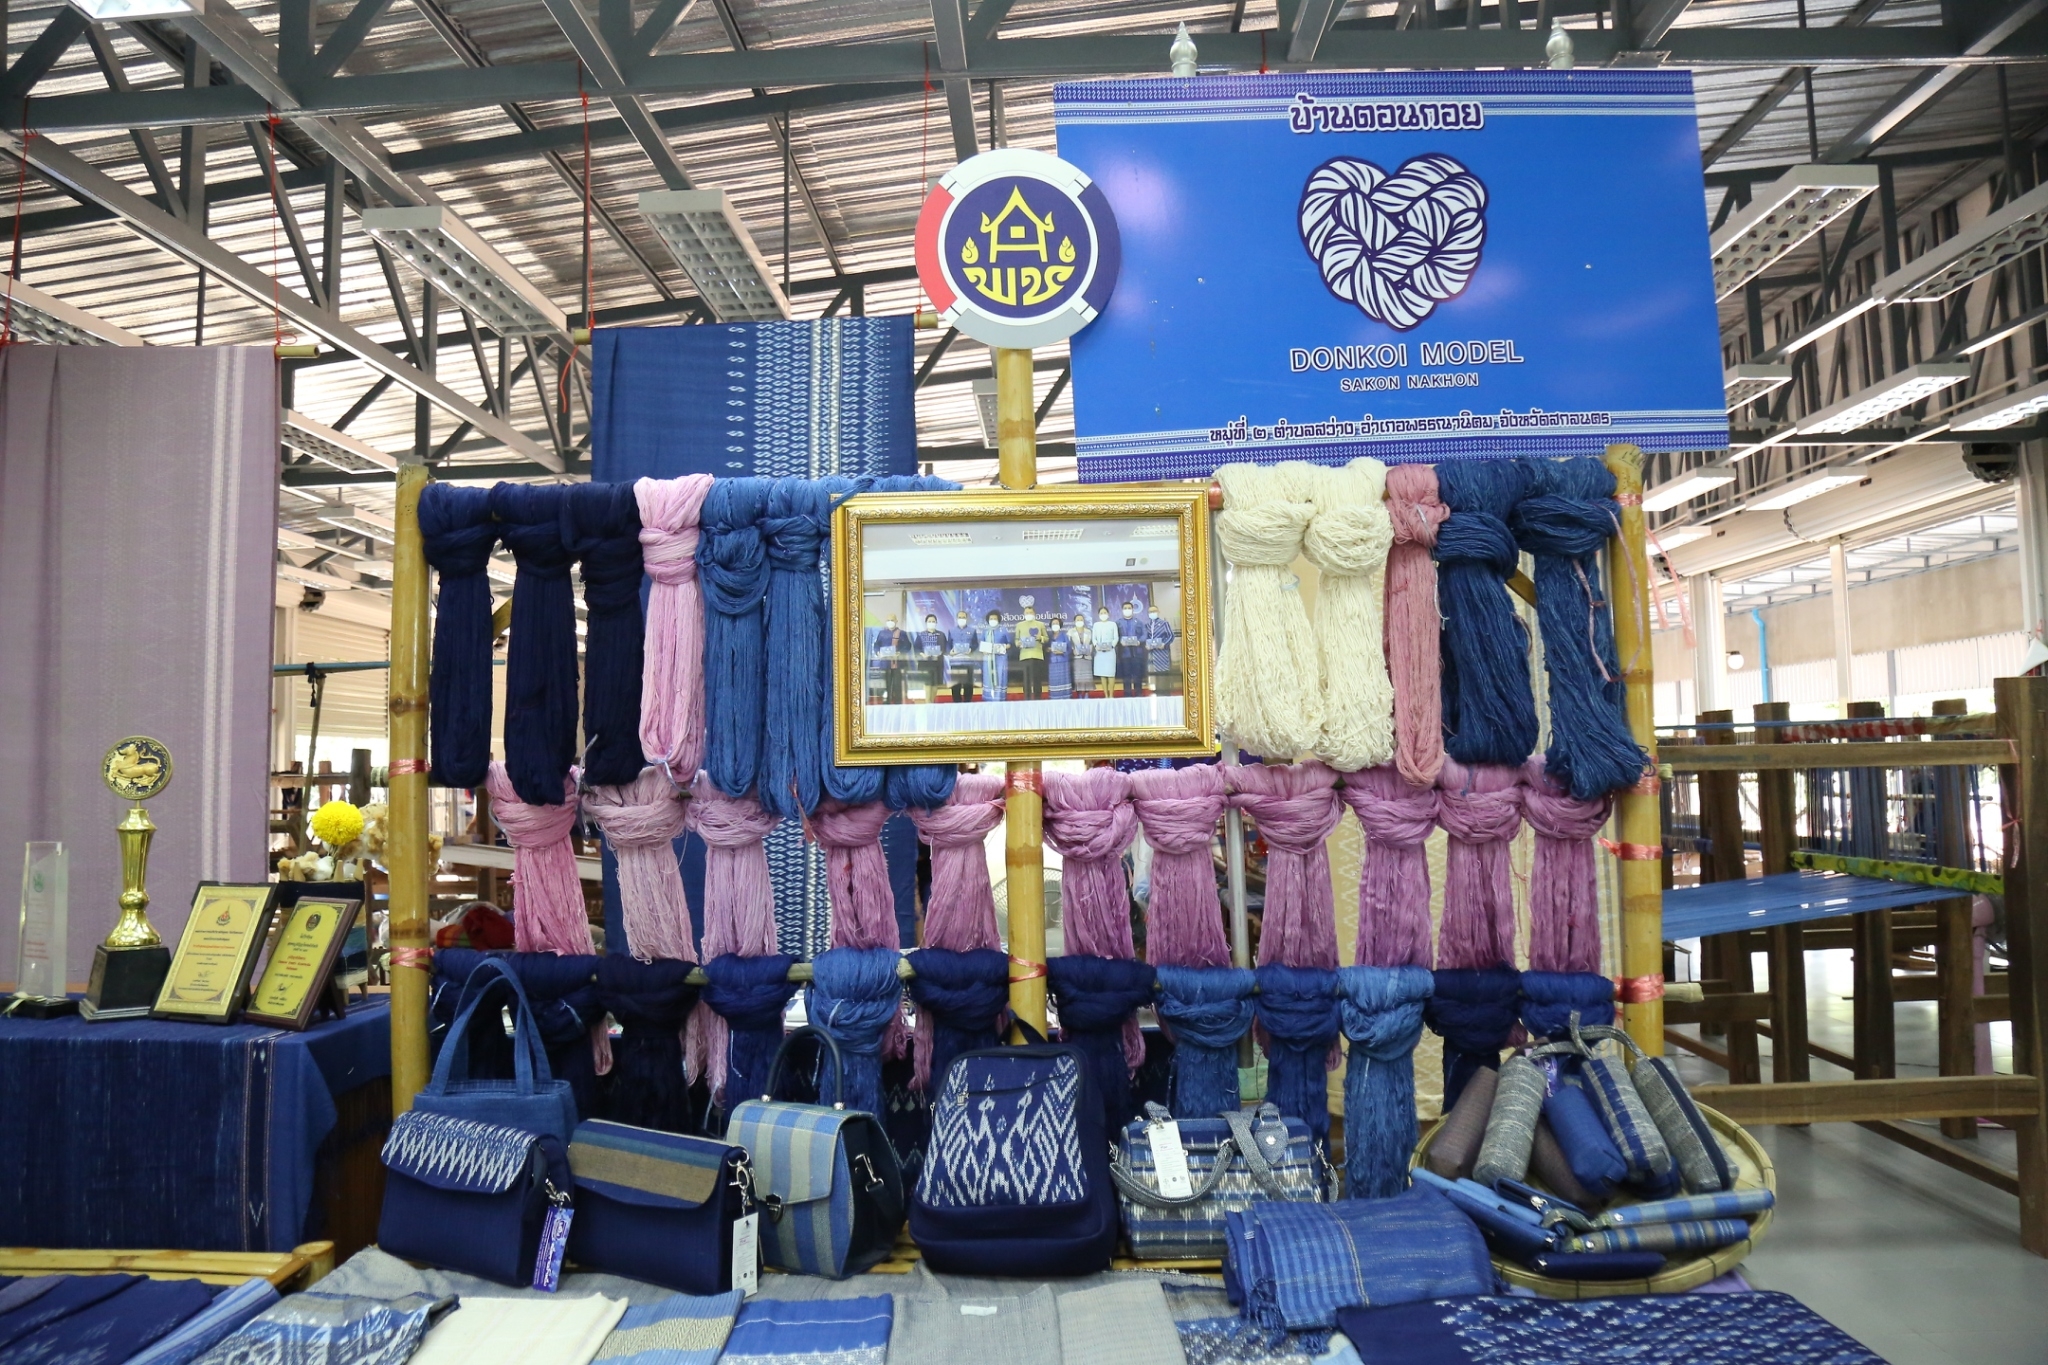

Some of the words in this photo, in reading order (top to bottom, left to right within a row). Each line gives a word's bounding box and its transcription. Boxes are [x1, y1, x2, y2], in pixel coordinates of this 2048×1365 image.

[1289, 94, 1483, 133] บ้านดอนกอย
[1290, 345, 1408, 372] DONKOI
[1421, 340, 1524, 365] MODEL
[1341, 376, 1400, 392] SAKON
[1408, 373, 1479, 389] NAKHON
[1209, 415, 1248, 446] หมู่ที่
[1253, 427, 1267, 440] ๒
[1274, 417, 1354, 440] ตำบลสว่าง
[1360, 411, 1493, 435] อำเภอพรรณานิคม
[1499, 408, 1611, 429] จังหวัดสกลนคร
